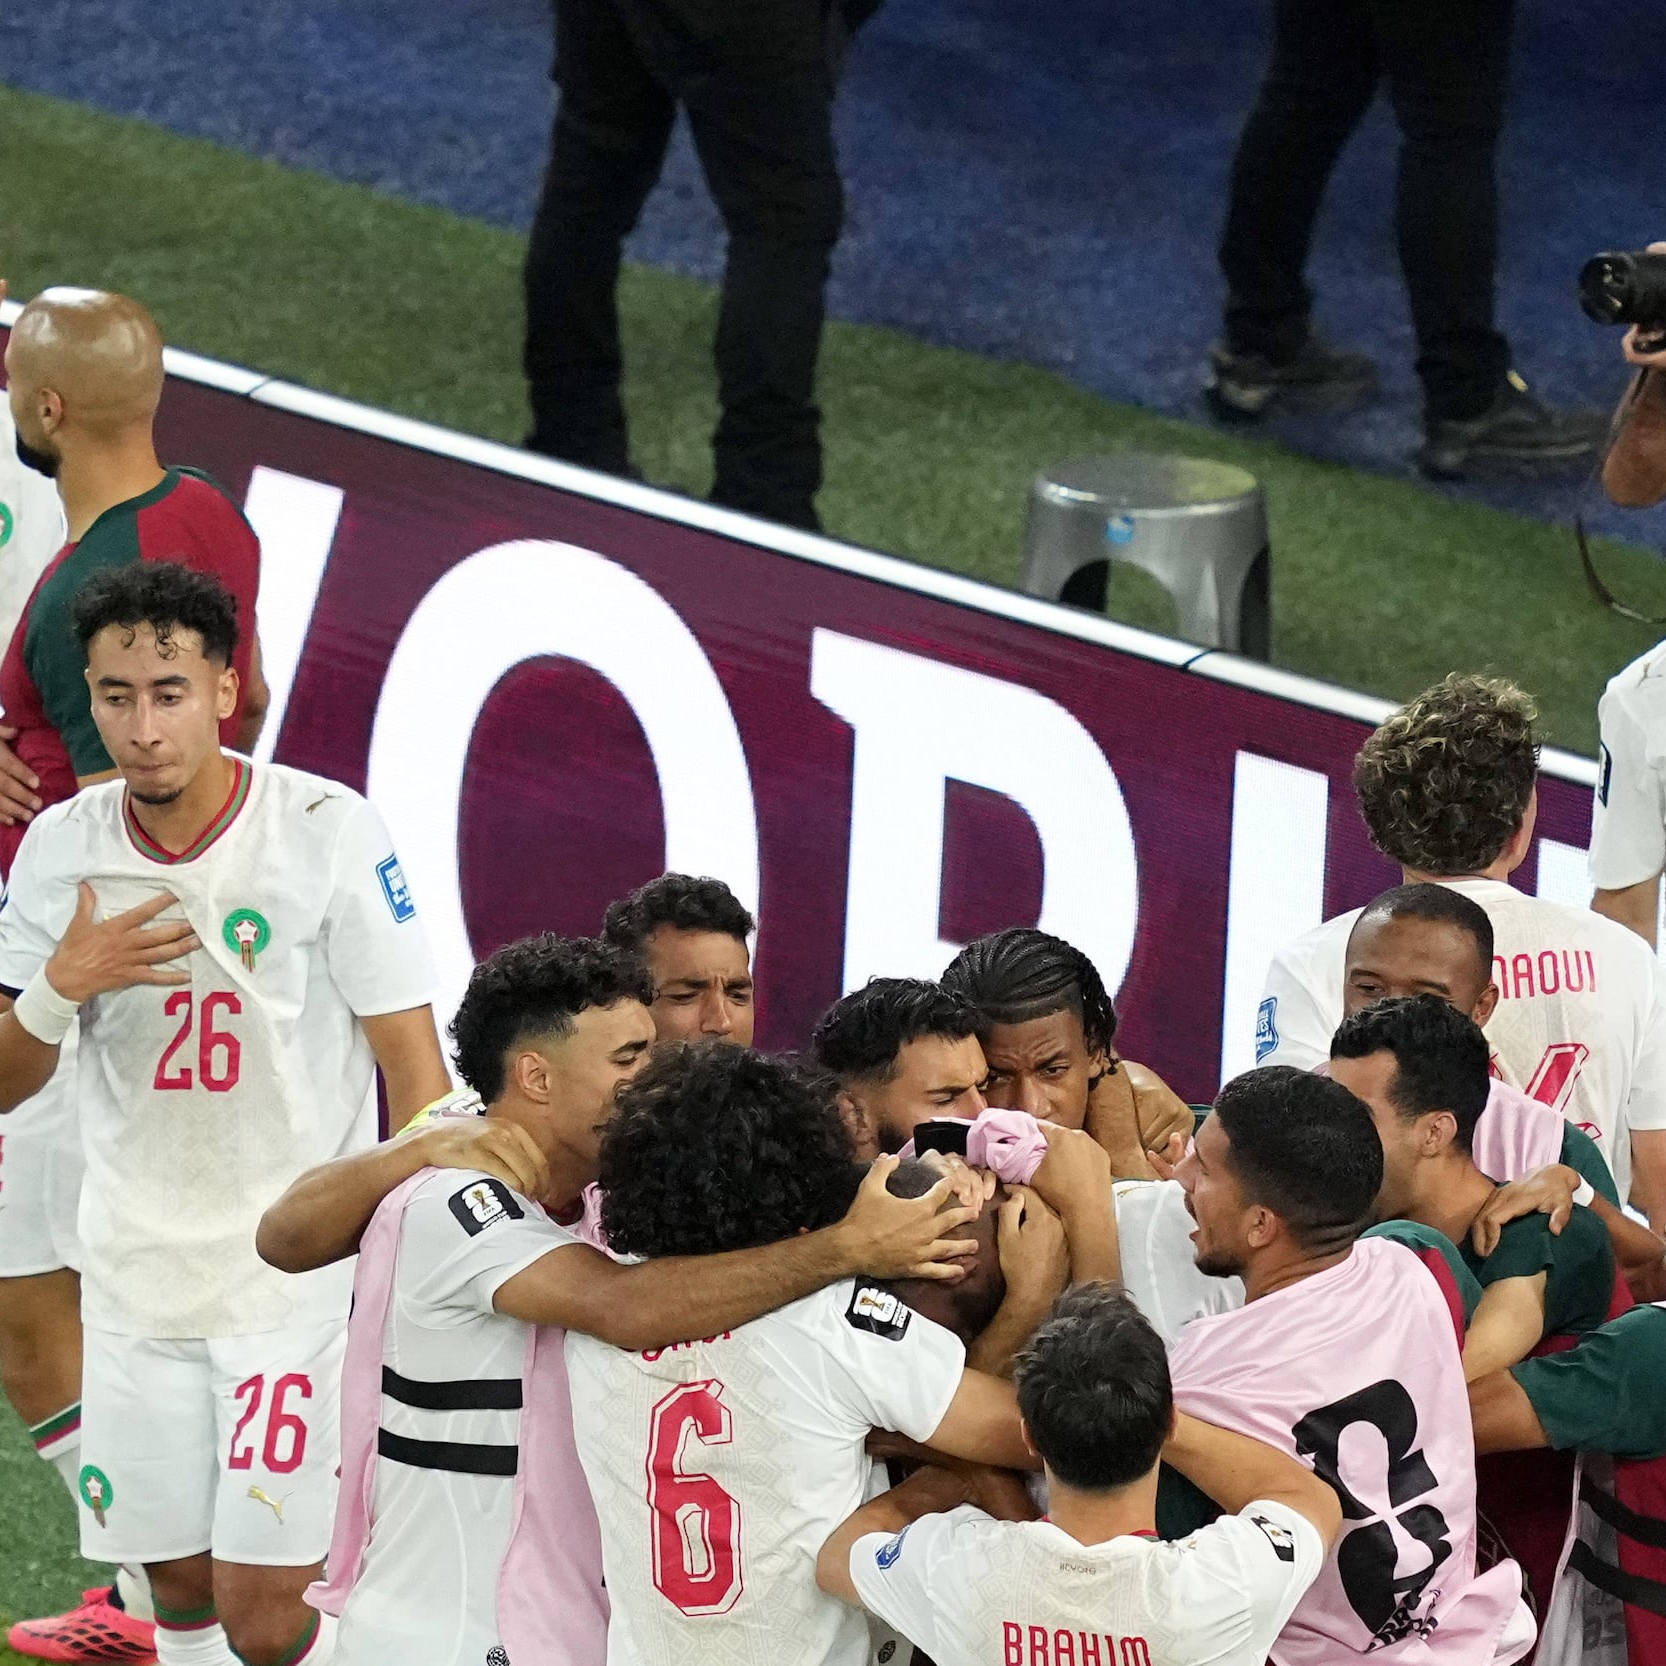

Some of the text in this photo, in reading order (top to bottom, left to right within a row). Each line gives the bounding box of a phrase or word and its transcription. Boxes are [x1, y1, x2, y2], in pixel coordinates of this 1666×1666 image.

[154, 990, 242, 1092] 26
[229, 1372, 314, 1474] 26
[644, 1378, 745, 1618] 6
